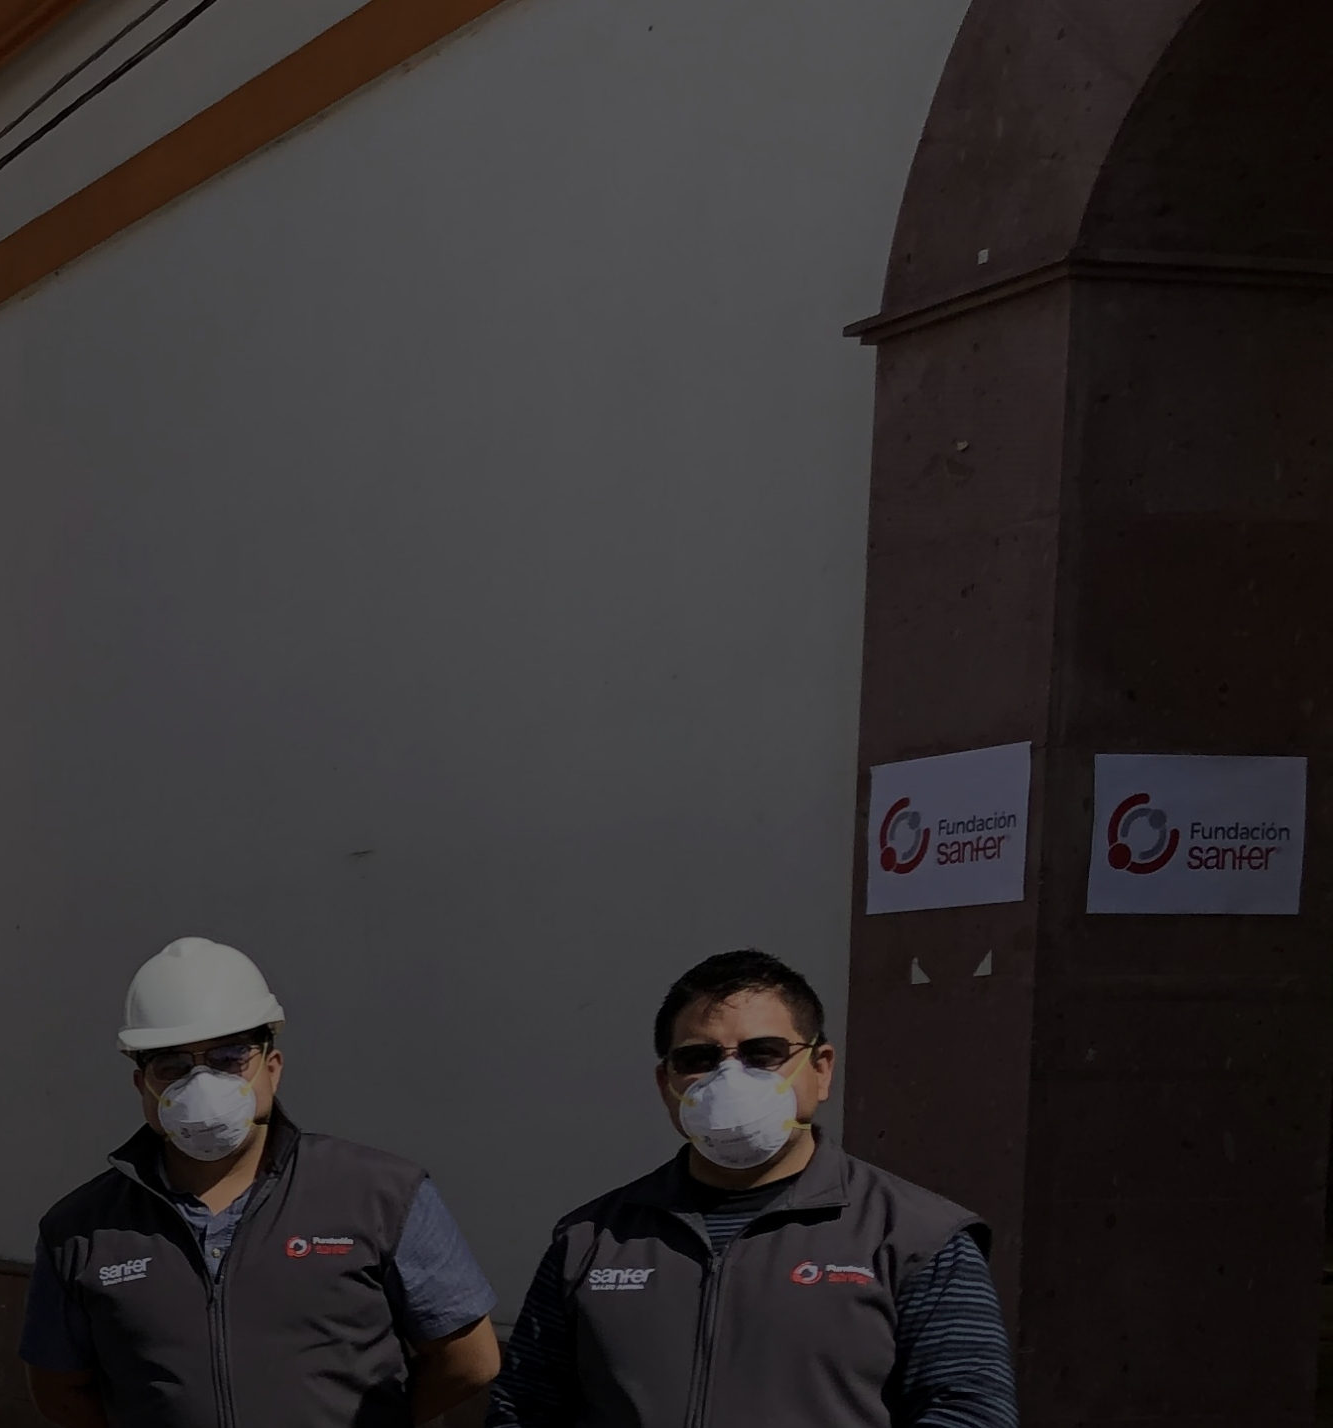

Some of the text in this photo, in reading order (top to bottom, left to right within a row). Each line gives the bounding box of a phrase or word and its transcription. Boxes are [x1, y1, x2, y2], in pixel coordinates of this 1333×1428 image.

[937, 810, 1017, 837] Fundación
[1190, 821, 1290, 841] Fundación
[936, 834, 1006, 866] sanfer
[1186, 844, 1276, 872] sanfer
[99, 1257, 152, 1281] sanfer
[588, 1268, 656, 1284] sanfer
